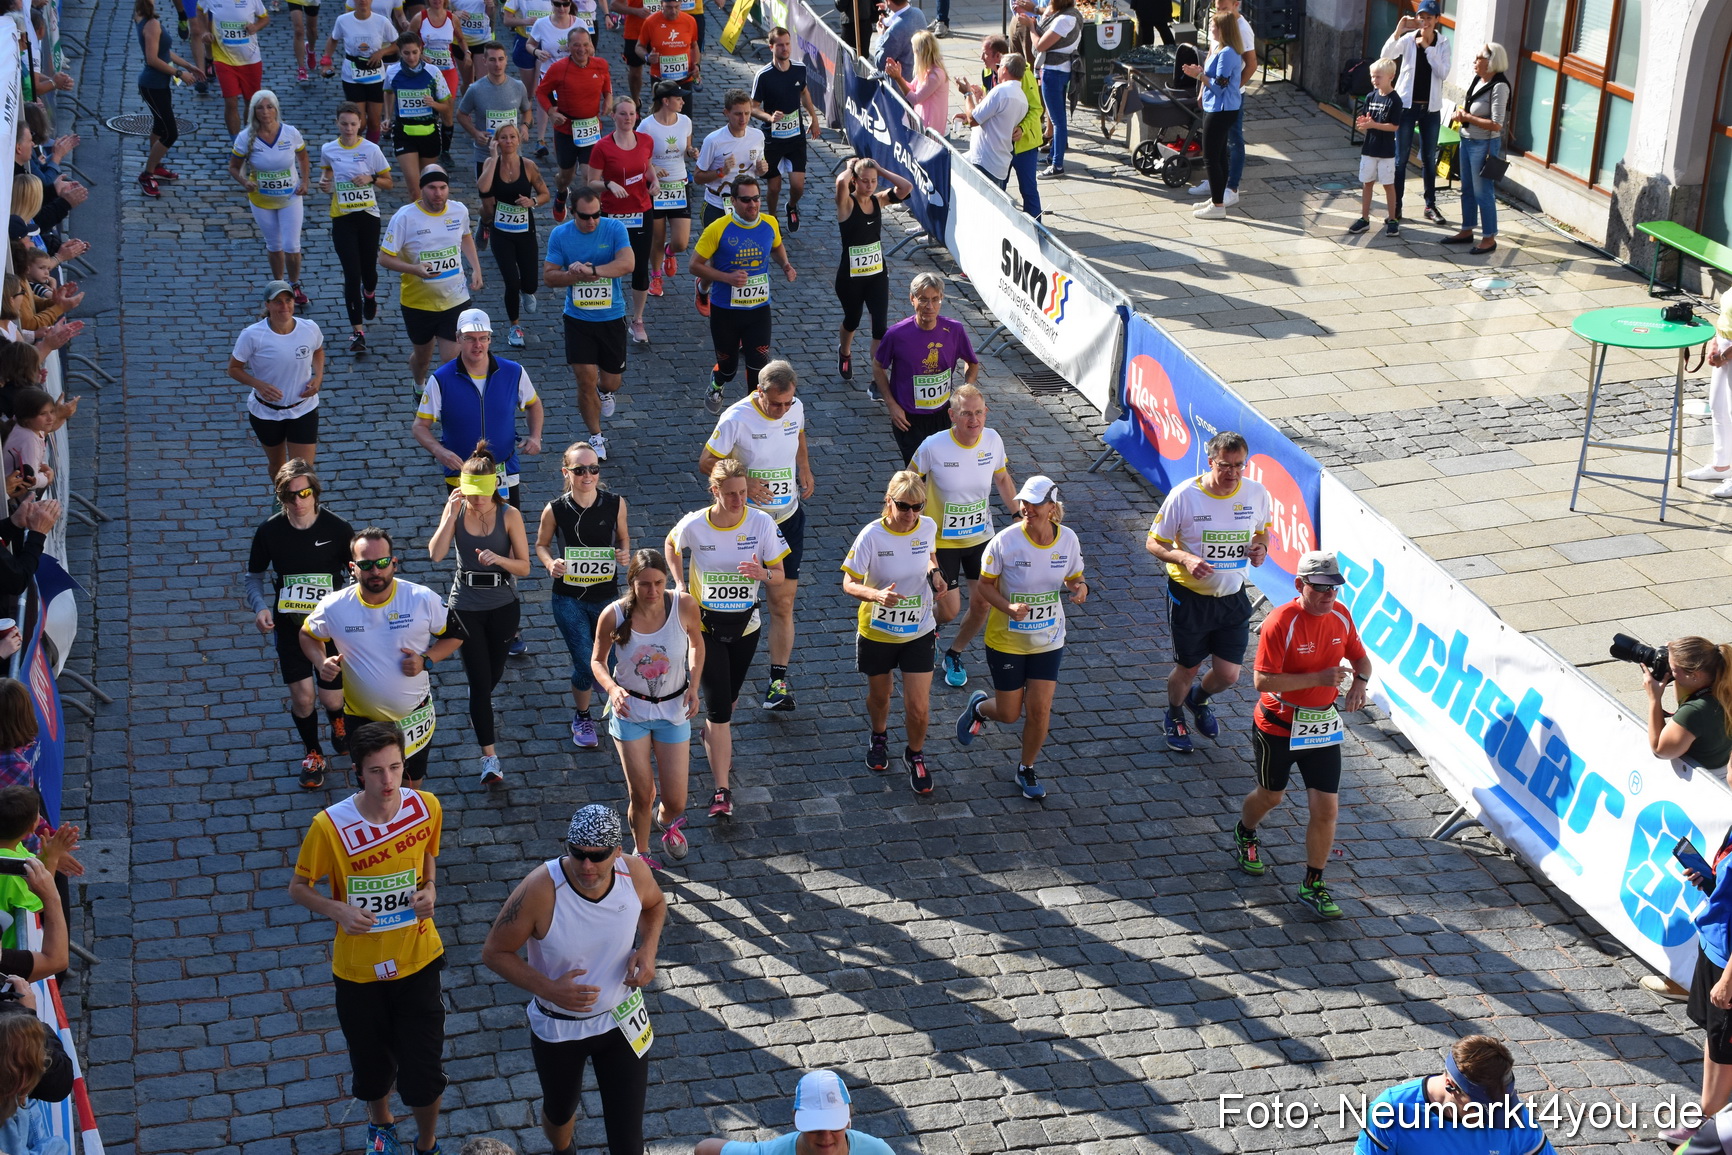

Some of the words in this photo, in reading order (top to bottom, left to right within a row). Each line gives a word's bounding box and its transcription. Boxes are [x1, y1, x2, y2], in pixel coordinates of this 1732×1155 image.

[461, 19, 483, 28] 2039
[224, 30, 248, 38] 2813
[431, 58, 449, 66] 282
[664, 63, 686, 73] 2501
[775, 121, 798, 131] 2503
[576, 126, 598, 138] 2339
[260, 171, 290, 179] BOCK
[261, 179, 289, 189] 2634
[341, 190, 370, 202] 1045
[657, 189, 682, 200] 2347
[499, 205, 529, 214] BOCK
[499, 213, 526, 224] 2743
[422, 249, 456, 260] BOCK
[853, 245, 879, 255] BOCK
[426, 257, 457, 272] 2740
[854, 253, 880, 266] 1270
[577, 287, 608, 299] 1073
[736, 286, 765, 298] 1074
[734, 297, 766, 305] CHRISTIAN
[1030, 307, 1059, 345] neumarkt
[917, 373, 948, 384] BOCK
[919, 381, 949, 399] 1017
[1130, 361, 1187, 445] Hervis
[752, 470, 789, 479] BOCK
[764, 481, 789, 496] 123
[949, 501, 984, 514] BOCK
[948, 512, 982, 528] 2113
[957, 528, 973, 536] UWE
[1206, 531, 1246, 542] BOCK
[569, 549, 610, 559] BOCK
[1206, 544, 1245, 559] 2549
[571, 562, 611, 575] 1026
[287, 575, 328, 586] BOCK
[707, 574, 751, 583] BOCK
[286, 585, 328, 601] 1158
[707, 586, 750, 600] 2098
[1015, 593, 1055, 604] BOCK
[708, 602, 747, 610] SUSANNE
[877, 608, 917, 623] 2114
[1028, 605, 1053, 620] 121
[887, 624, 905, 633] LISA
[1017, 621, 1049, 629] CLAUDIA
[400, 709, 431, 728] BOC
[1299, 710, 1337, 721] BOCK
[406, 718, 433, 742] 130
[1297, 719, 1339, 736] 2431
[1303, 736, 1332, 744] ERWIN
[350, 848, 392, 872] MAX
[353, 874, 410, 891] BOCK
[355, 891, 410, 914] 2384
[373, 914, 402, 926] UKAS
[628, 1007, 648, 1032] 10
